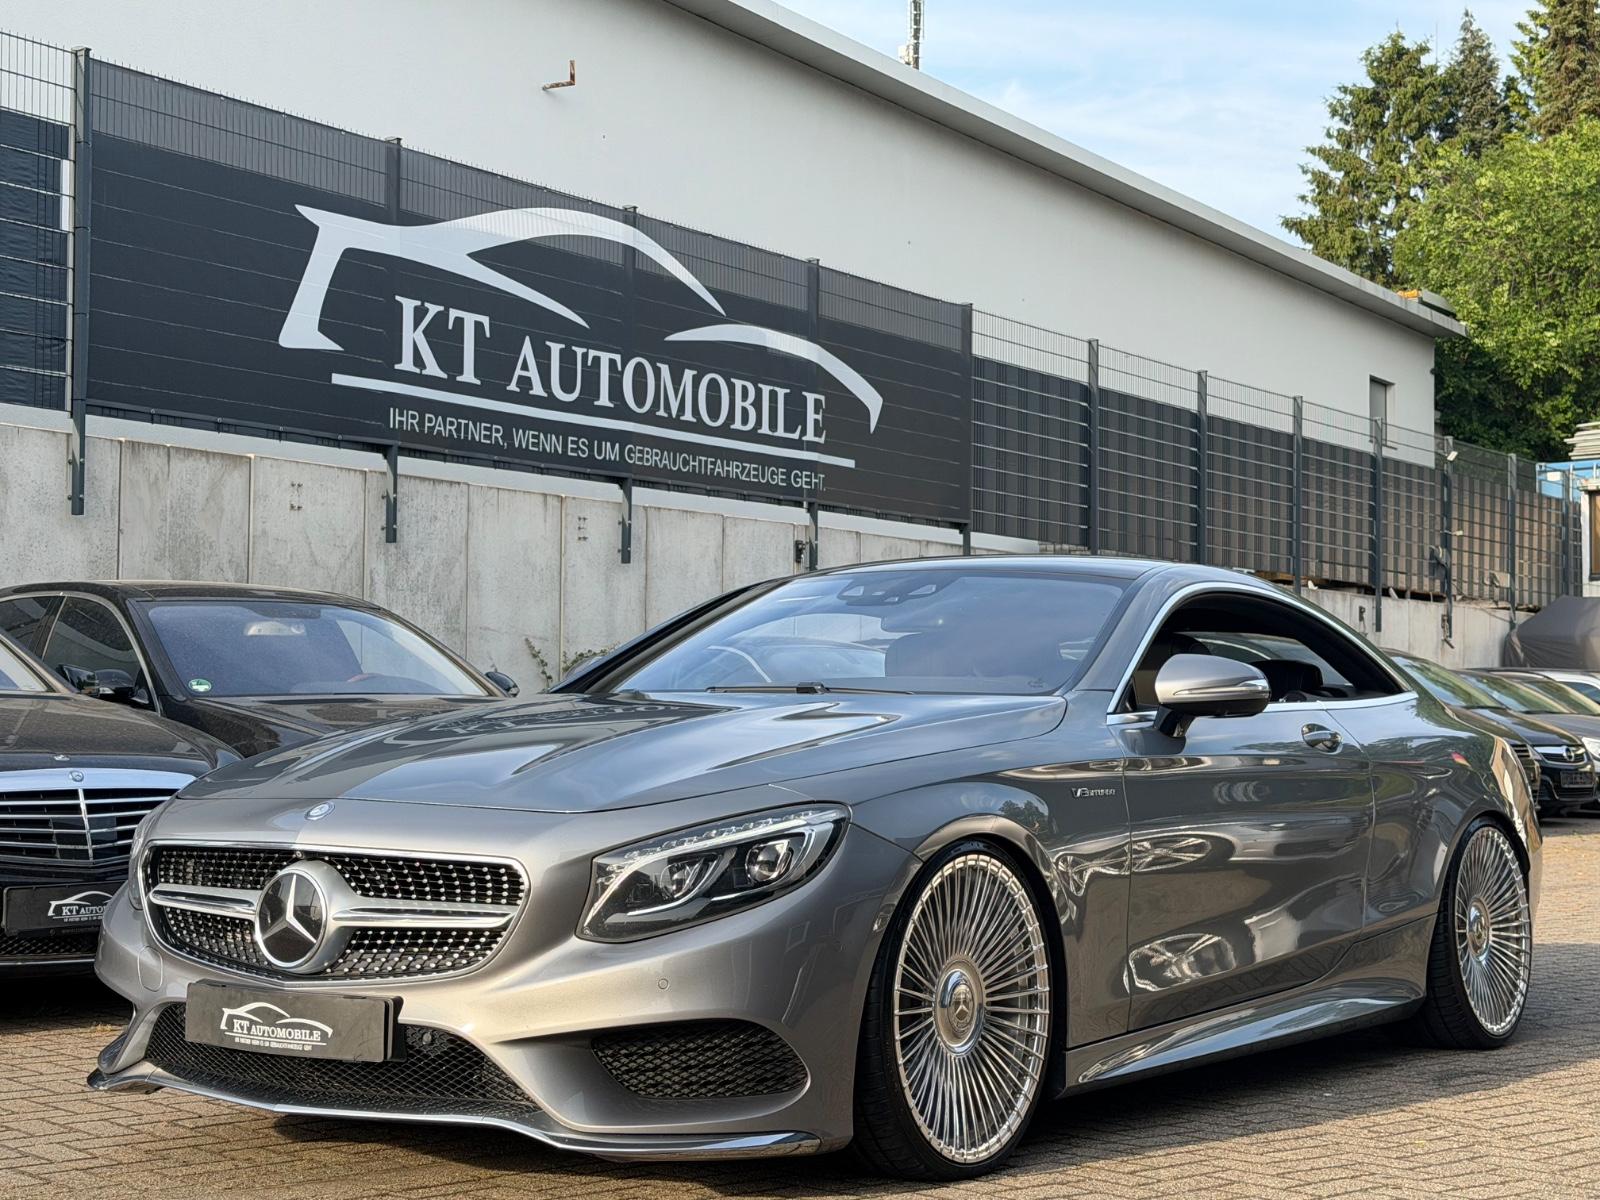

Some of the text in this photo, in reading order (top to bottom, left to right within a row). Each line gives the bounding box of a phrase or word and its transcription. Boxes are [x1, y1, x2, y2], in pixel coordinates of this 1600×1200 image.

[394, 295, 826, 444] KT AUTOMOBILE
[389, 407, 419, 432] IHR
[424, 413, 508, 449] PARTNER,
[513, 427, 563, 455] WENN
[567, 436, 589, 458] ES
[593, 440, 620, 462] UM
[624, 444, 787, 486] GEBRAUCHTFAHRZEUGE
[62, 906, 105, 915] KT AUTO
[233, 1019, 321, 1041] KT AUTOMOBILE
